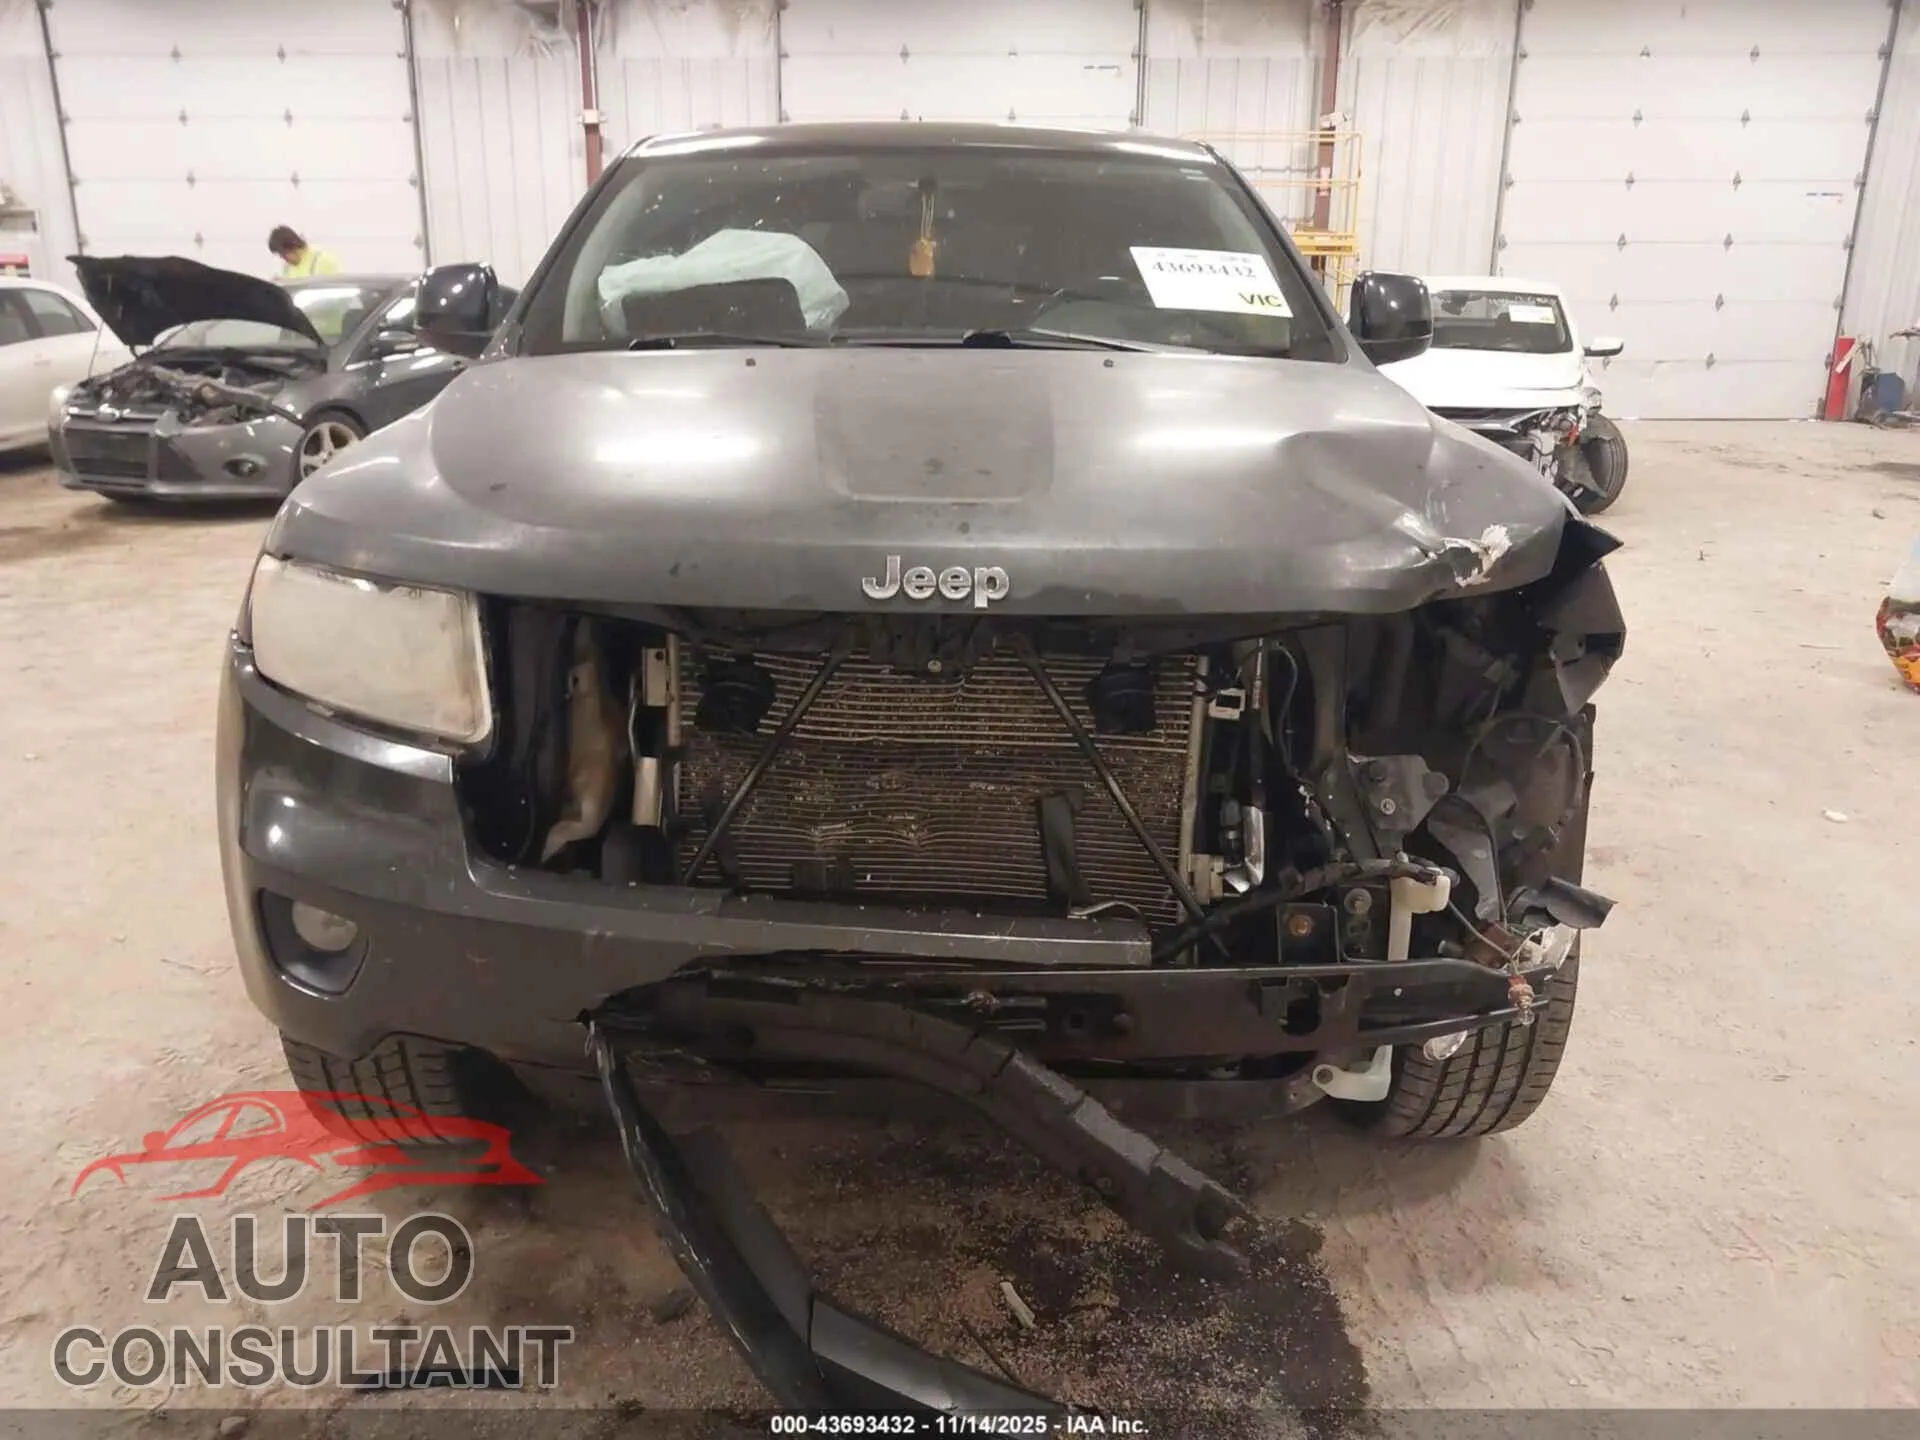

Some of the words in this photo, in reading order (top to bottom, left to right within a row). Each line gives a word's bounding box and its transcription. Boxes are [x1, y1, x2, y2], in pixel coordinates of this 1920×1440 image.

[1152, 261, 1257, 278] 43693432
[1238, 292, 1282, 308] VIC
[862, 554, 1010, 609] Jeep
